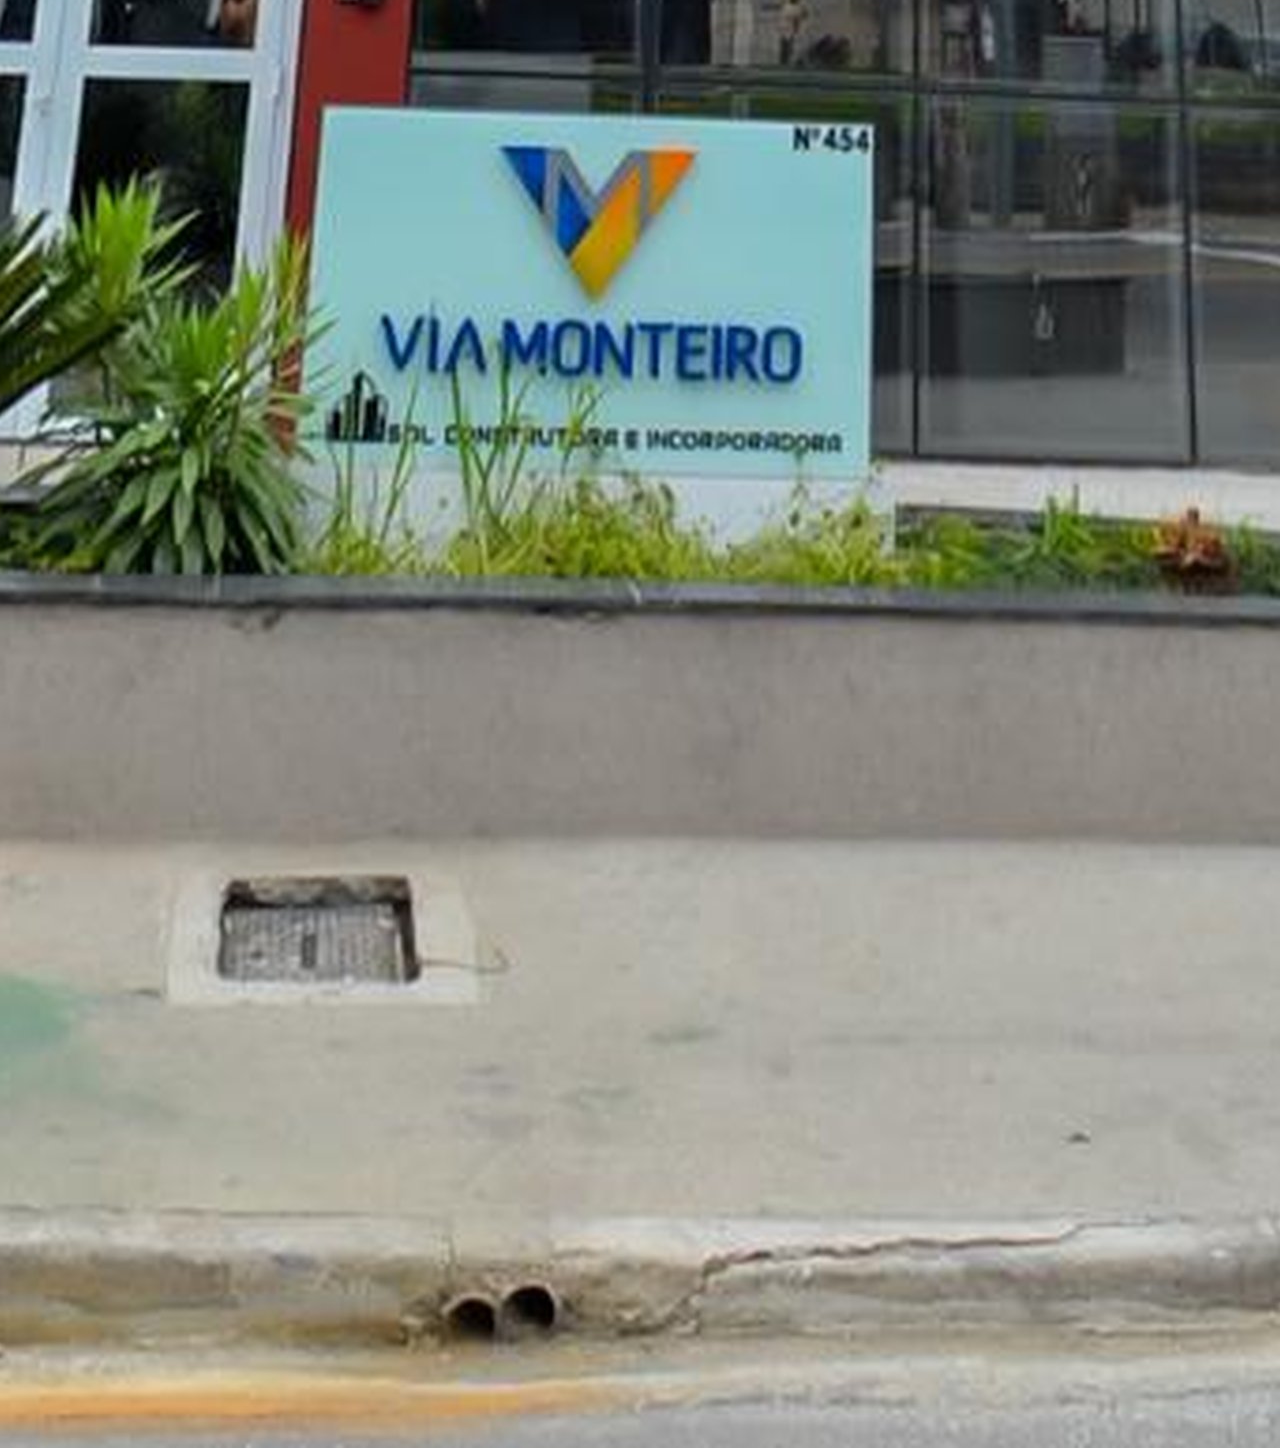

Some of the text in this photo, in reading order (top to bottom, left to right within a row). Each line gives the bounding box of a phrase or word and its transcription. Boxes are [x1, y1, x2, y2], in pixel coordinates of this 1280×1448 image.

[381, 314, 803, 384] VIA MONTEIRO
[645, 428, 843, 453] INCORPORADORA
